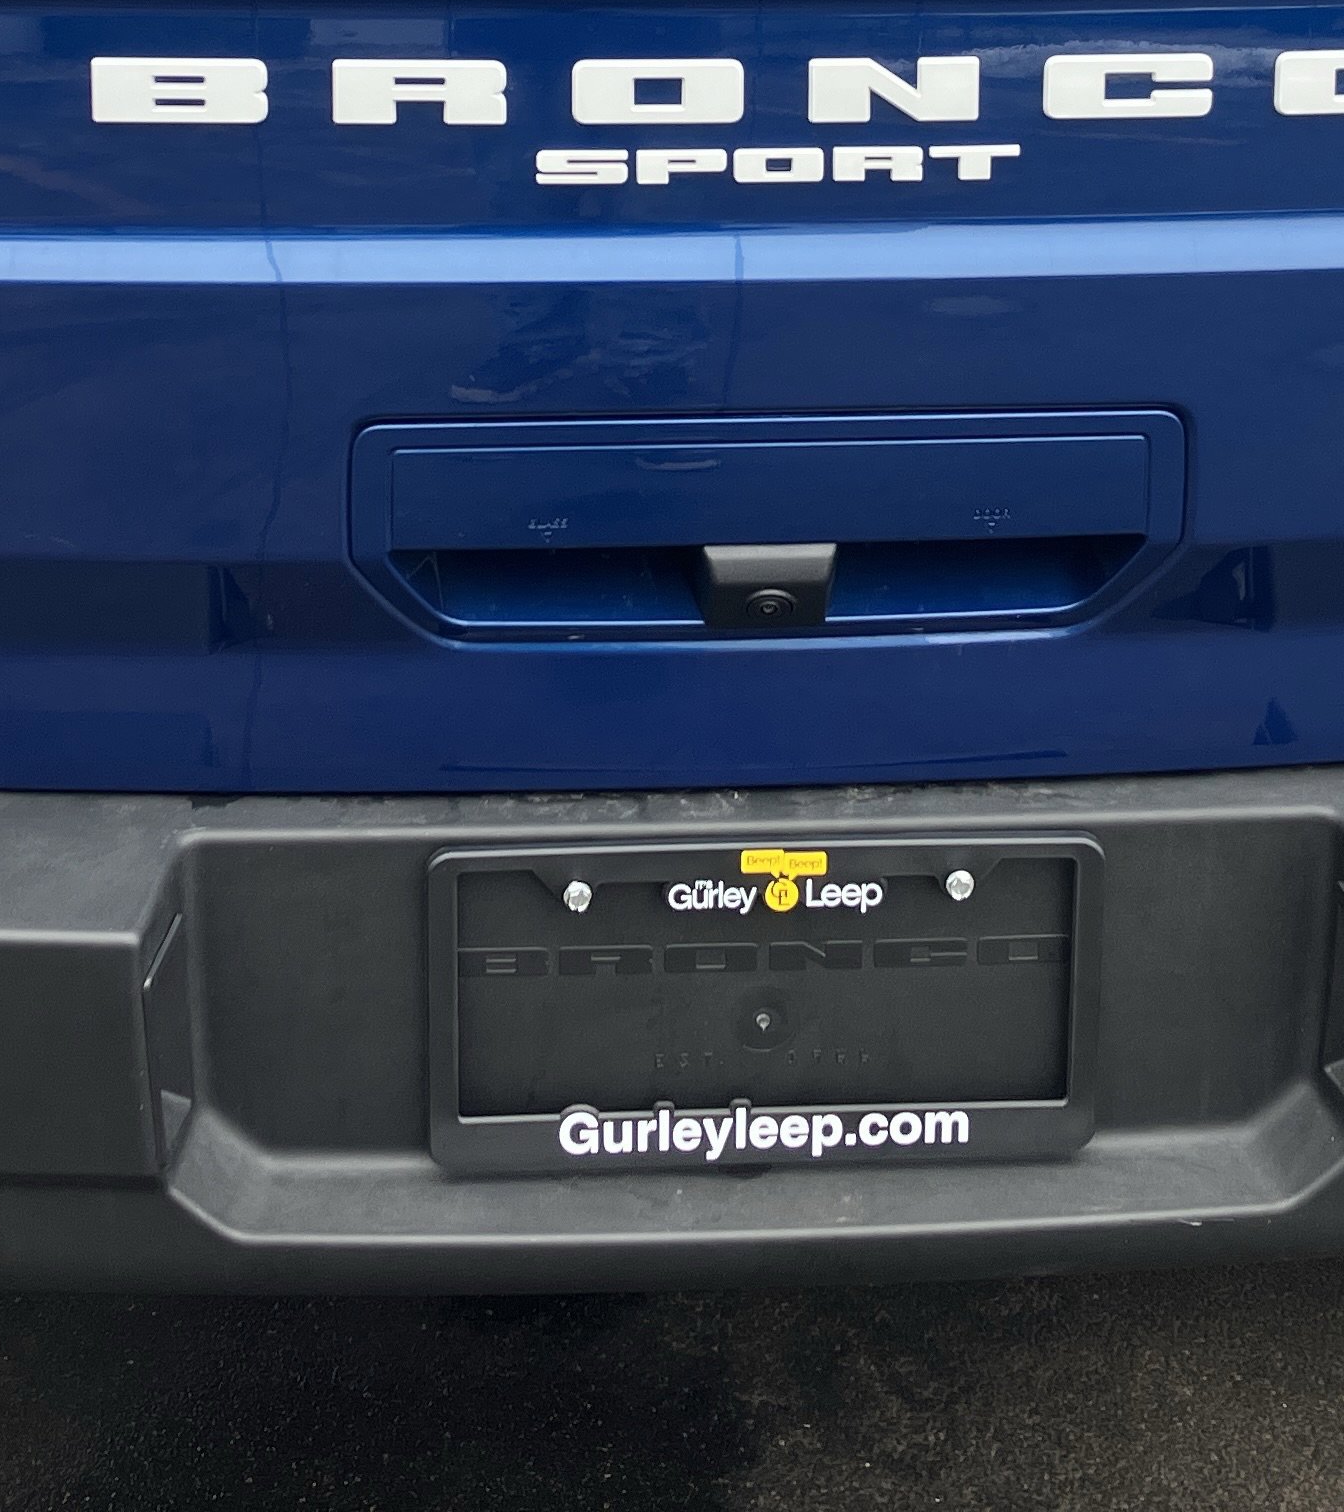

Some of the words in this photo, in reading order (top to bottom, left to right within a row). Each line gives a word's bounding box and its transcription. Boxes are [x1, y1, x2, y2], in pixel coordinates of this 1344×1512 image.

[534, 142, 1022, 185] SPORT
[746, 855, 781, 867] Beep!
[789, 857, 823, 870] Beep!
[805, 878, 884, 914] Leep
[456, 935, 1068, 977] BRONCO
[558, 1109, 970, 1160] Gurleyleep.com
